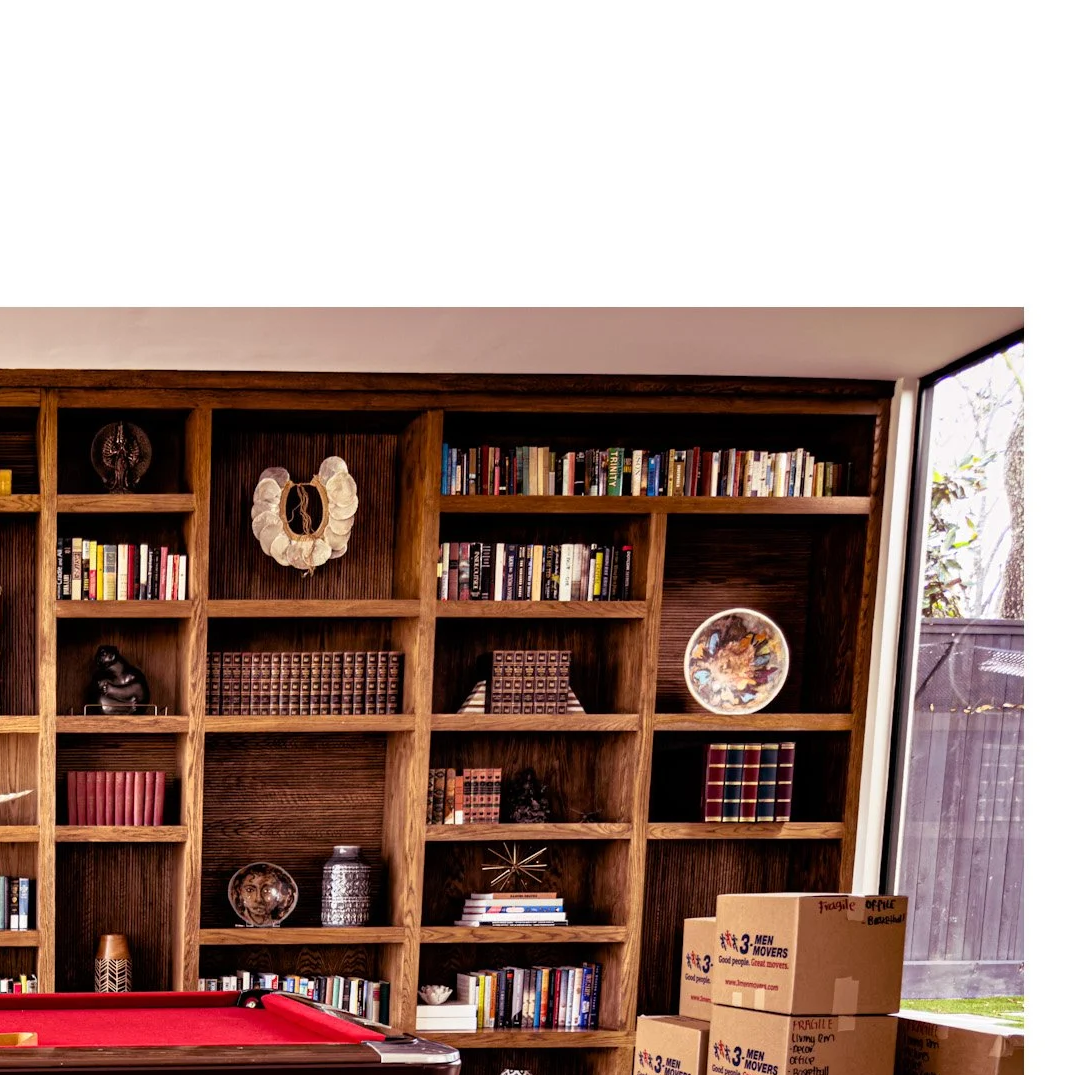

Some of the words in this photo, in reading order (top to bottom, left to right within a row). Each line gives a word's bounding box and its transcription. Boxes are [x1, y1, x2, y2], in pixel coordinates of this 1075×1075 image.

[609, 451, 618, 487] TRINITY
[819, 899, 855, 913] Fragile
[754, 934, 774, 946] MEN
[752, 945, 788, 959] MOVERS
[718, 955, 731, 965] Good
[731, 957, 750, 968] people.
[751, 958, 766, 968] Great
[766, 961, 789, 970] movers.
[685, 973, 696, 982] Good
[725, 979, 779, 991] www.3menmovers.com
[792, 1018, 833, 1031] FRAGILE
[746, 1048, 765, 1061] MEN
[666, 1057, 681, 1069] MEN
[712, 1064, 724, 1075] Good
[744, 1058, 778, 1075] MOVERS
